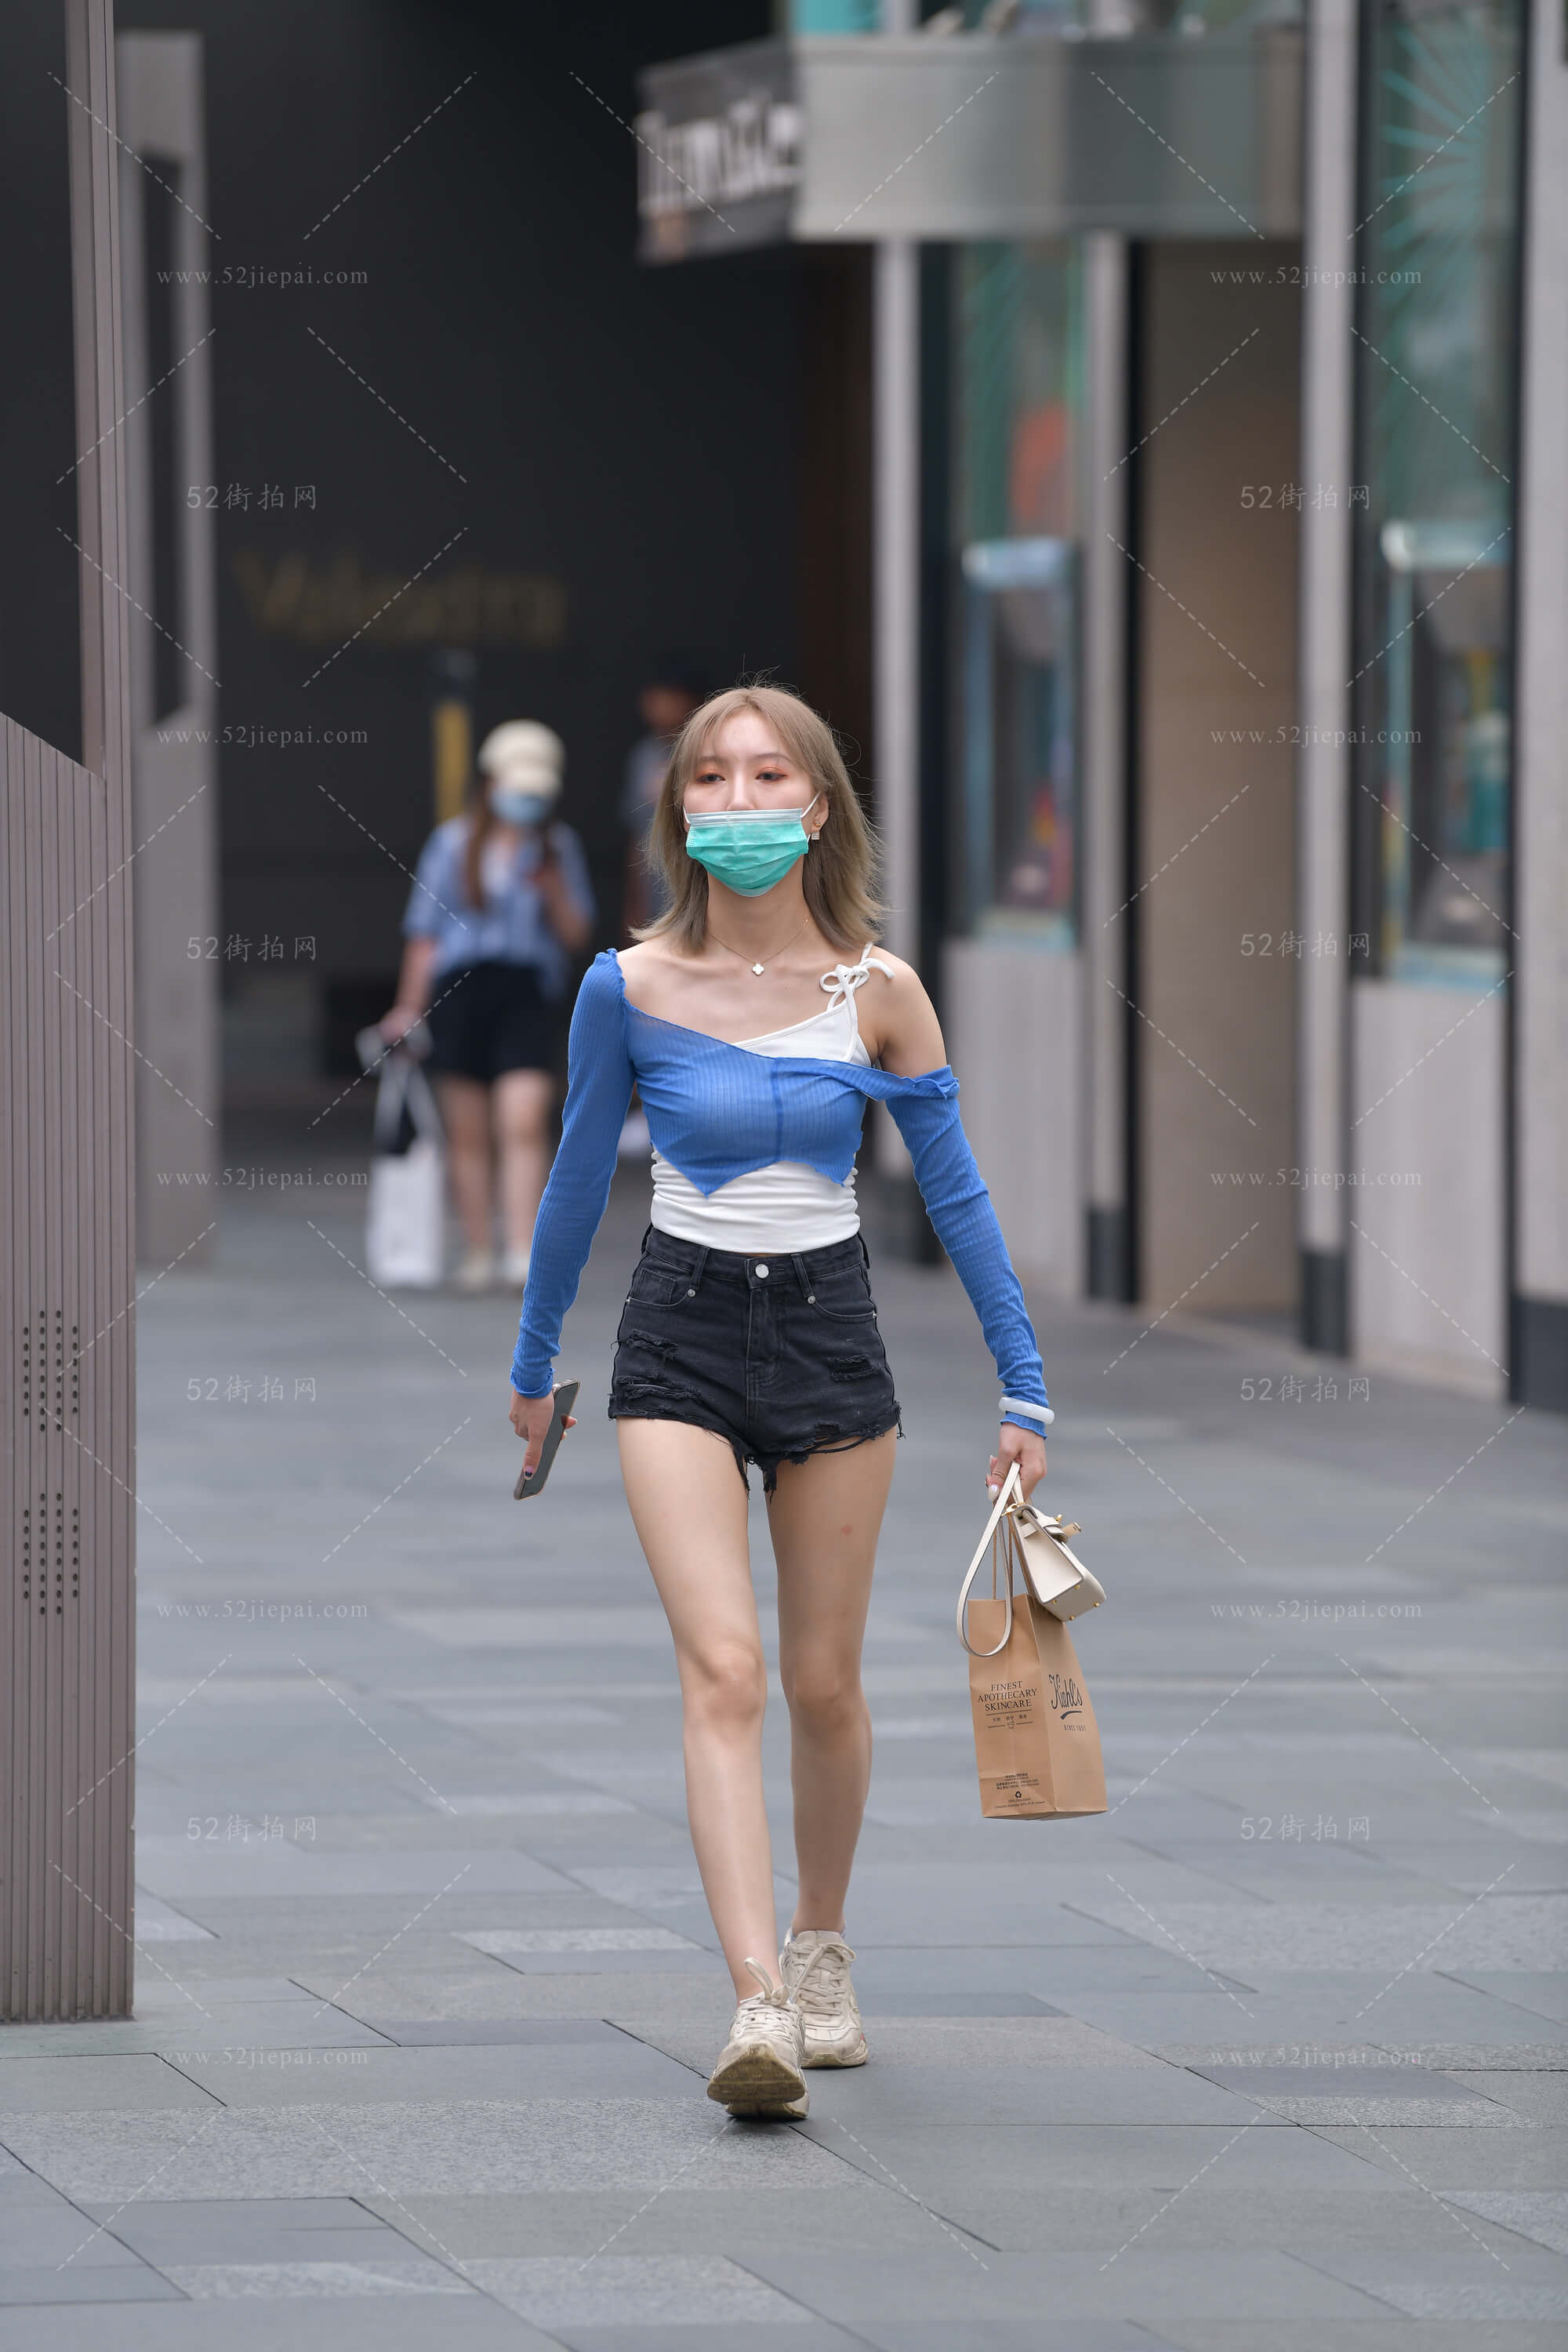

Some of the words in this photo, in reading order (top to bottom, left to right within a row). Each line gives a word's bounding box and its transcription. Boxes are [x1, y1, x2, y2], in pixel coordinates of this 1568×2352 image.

[991, 1681, 1022, 1692] FINEST
[1049, 1674, 1083, 1709] Kiehl's
[978, 1688, 1037, 1703] APOTHECARY
[985, 1699, 1032, 1711] SKINCARE
